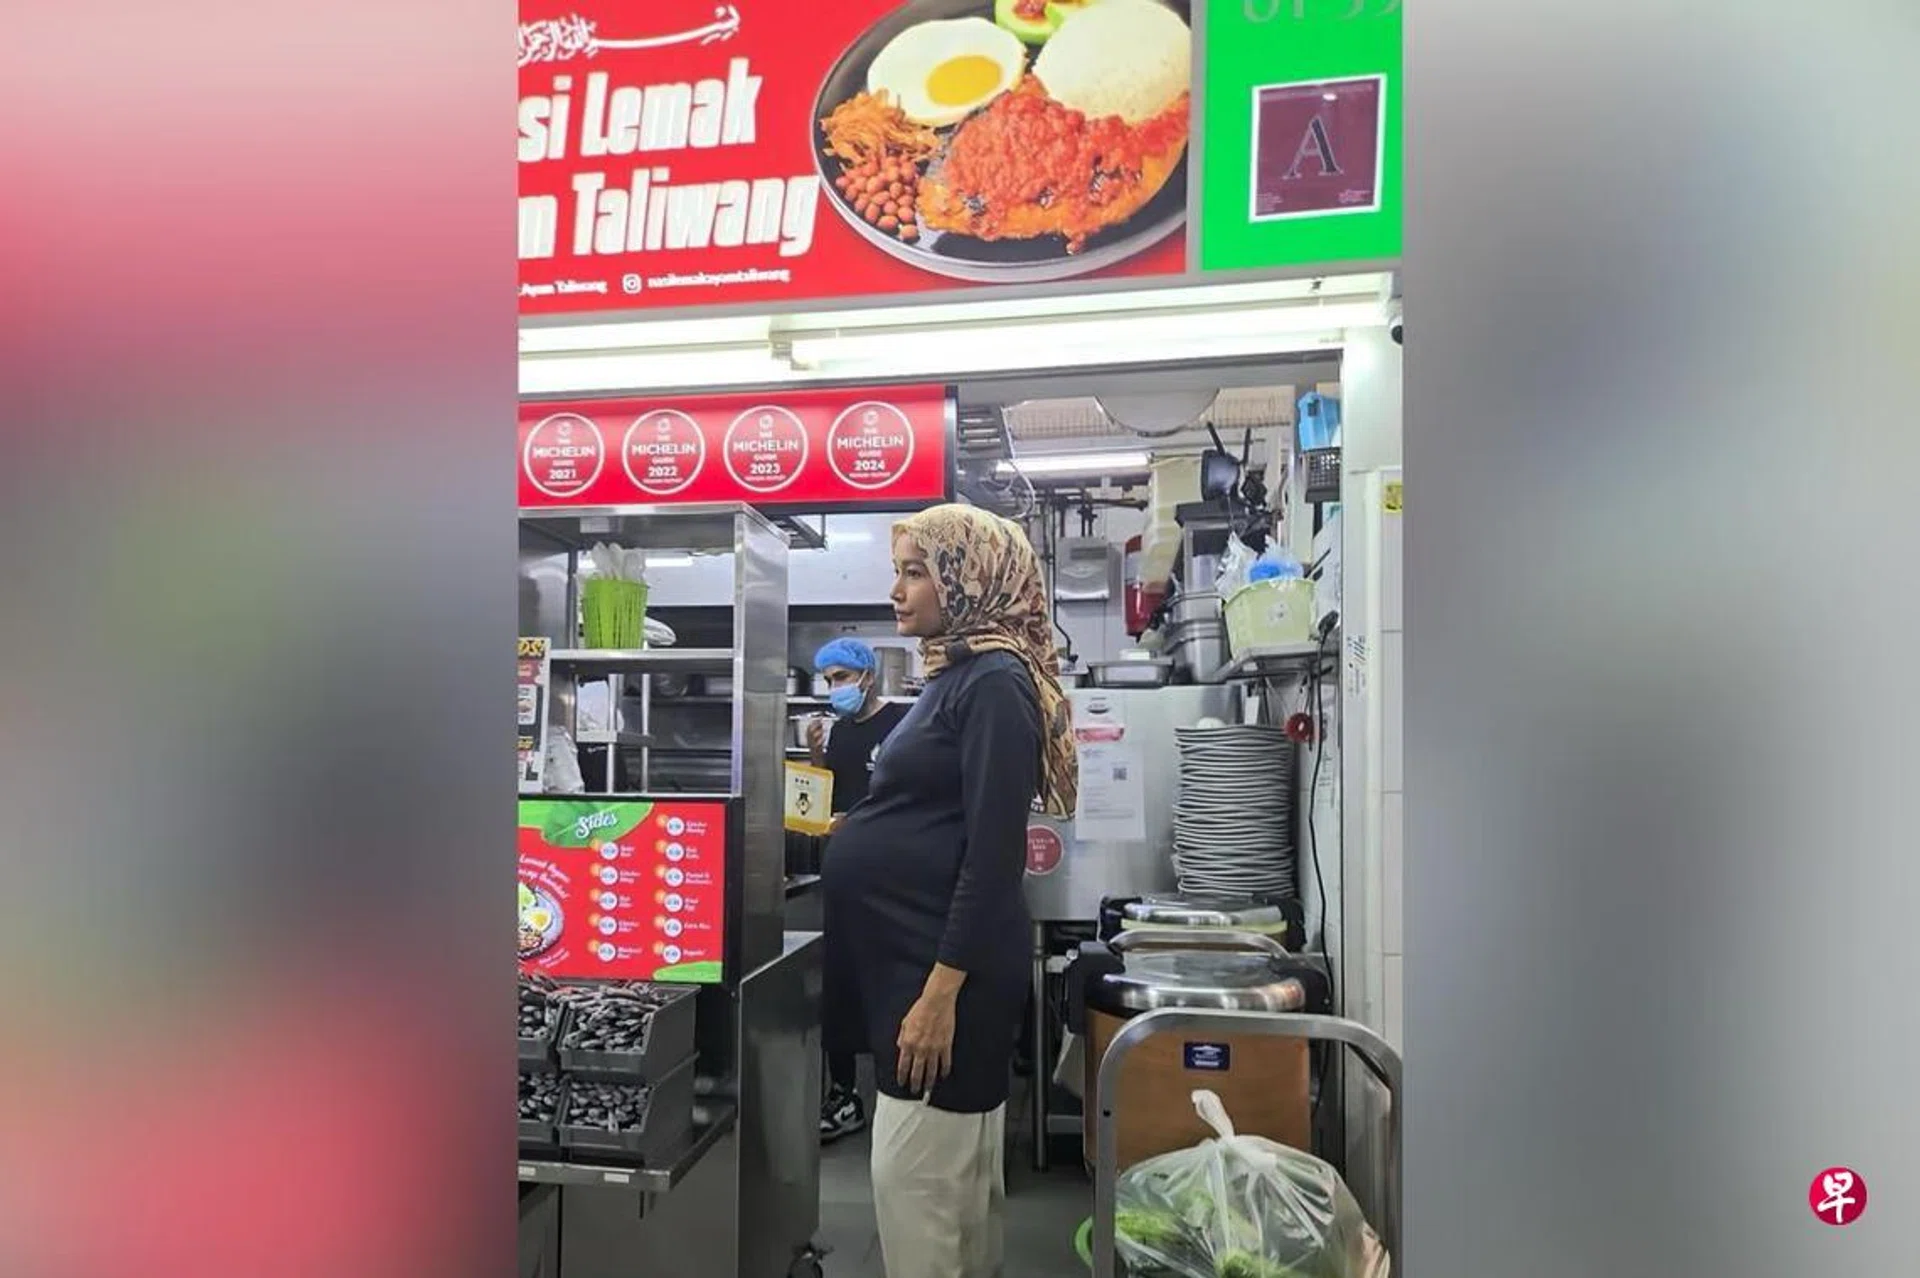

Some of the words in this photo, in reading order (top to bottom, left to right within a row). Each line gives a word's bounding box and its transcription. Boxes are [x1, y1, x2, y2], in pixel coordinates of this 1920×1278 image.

[580, 57, 763, 157] Lemak
[1281, 115, 1345, 180] A
[572, 167, 820, 257] Taliwang
[732, 439, 799, 453] MICHELIN
[837, 436, 904, 449] MICHELIN
[533, 445, 596, 458] MICHELIN
[631, 443, 697, 456] MICHELIN
[648, 466, 677, 478] 2022
[750, 463, 780, 474] 2023
[854, 460, 885, 471] 2024
[549, 469, 576, 480] 2021
[576, 812, 618, 839] Sides
